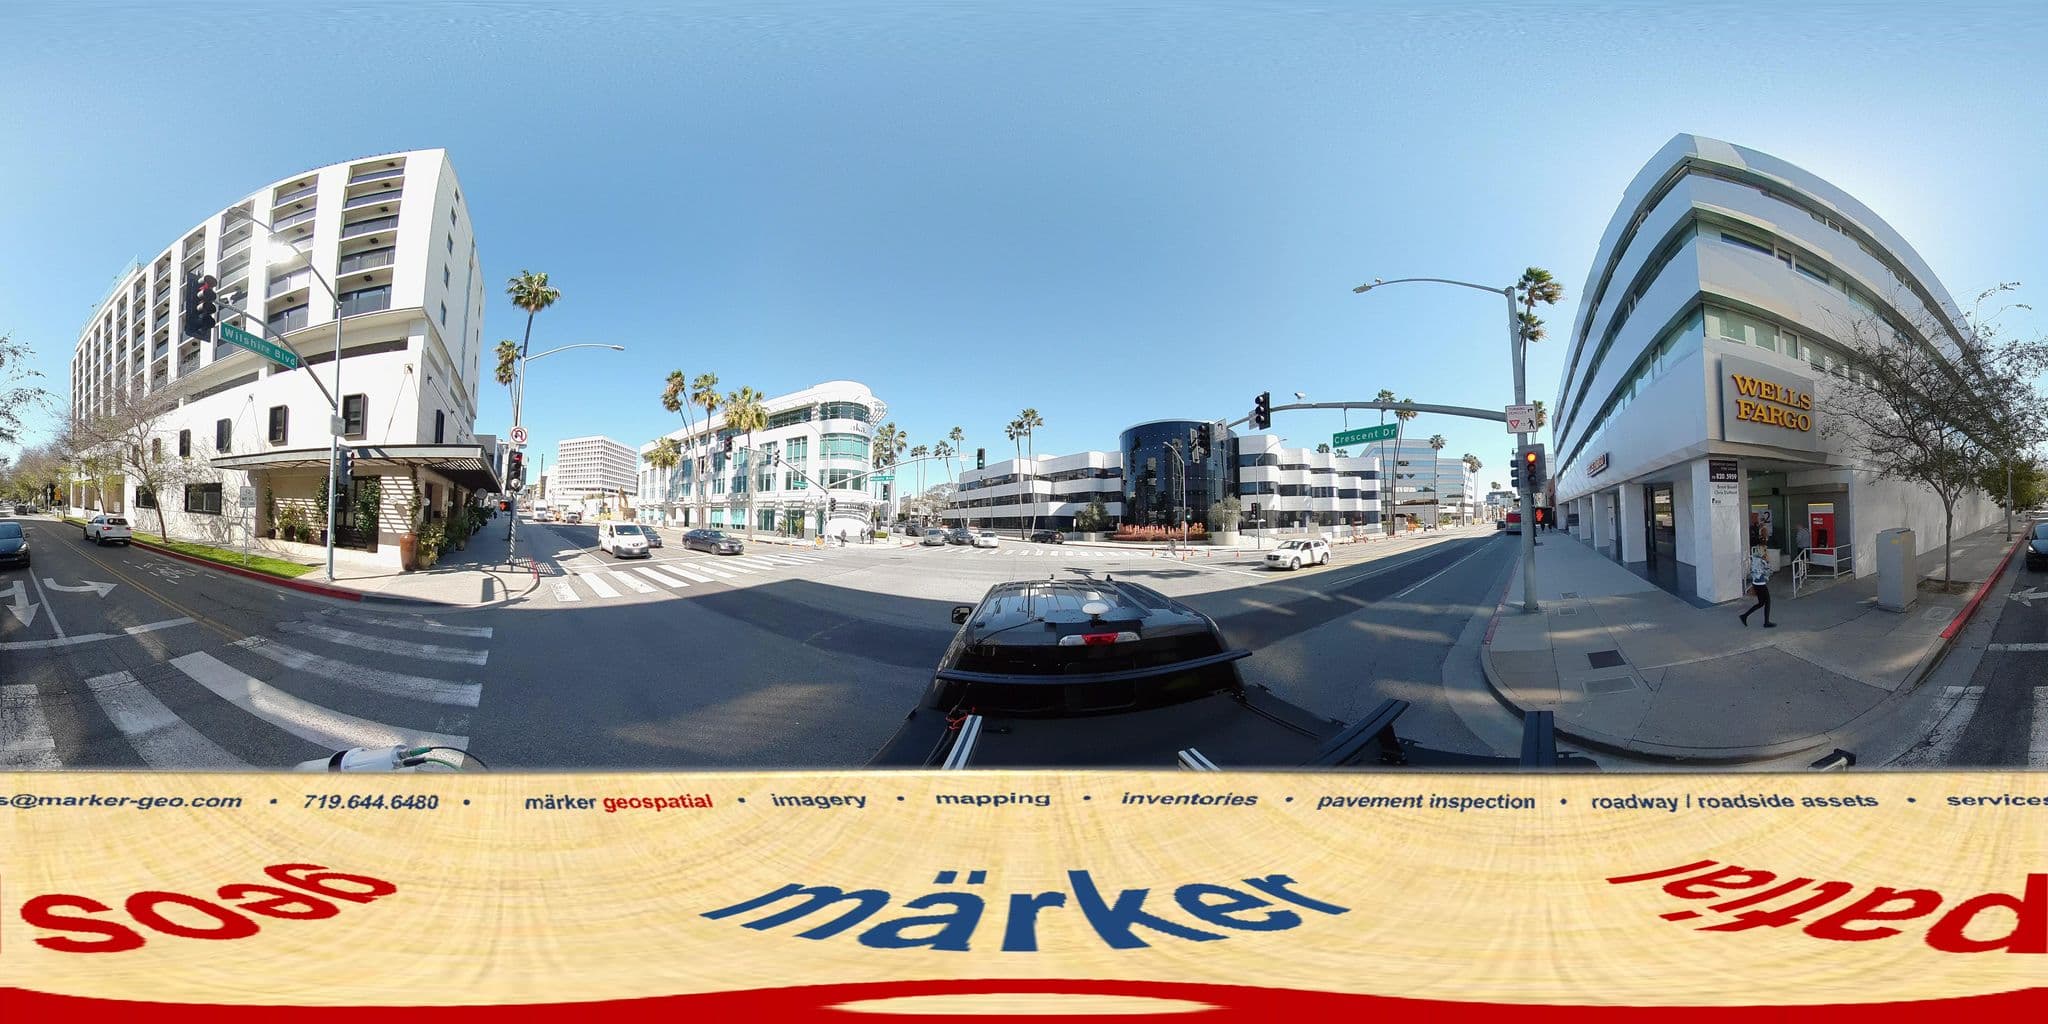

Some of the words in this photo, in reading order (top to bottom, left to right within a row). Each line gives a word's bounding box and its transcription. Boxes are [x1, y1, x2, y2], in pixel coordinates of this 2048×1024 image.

[224, 327, 271, 354] Wilshire
[274, 348, 296, 366] Blvd
[1732, 374, 1811, 411] WELLS
[1736, 399, 1811, 432] FARGO
[1334, 429, 1378, 444] Crescent
[1383, 428, 1395, 437] Dr
